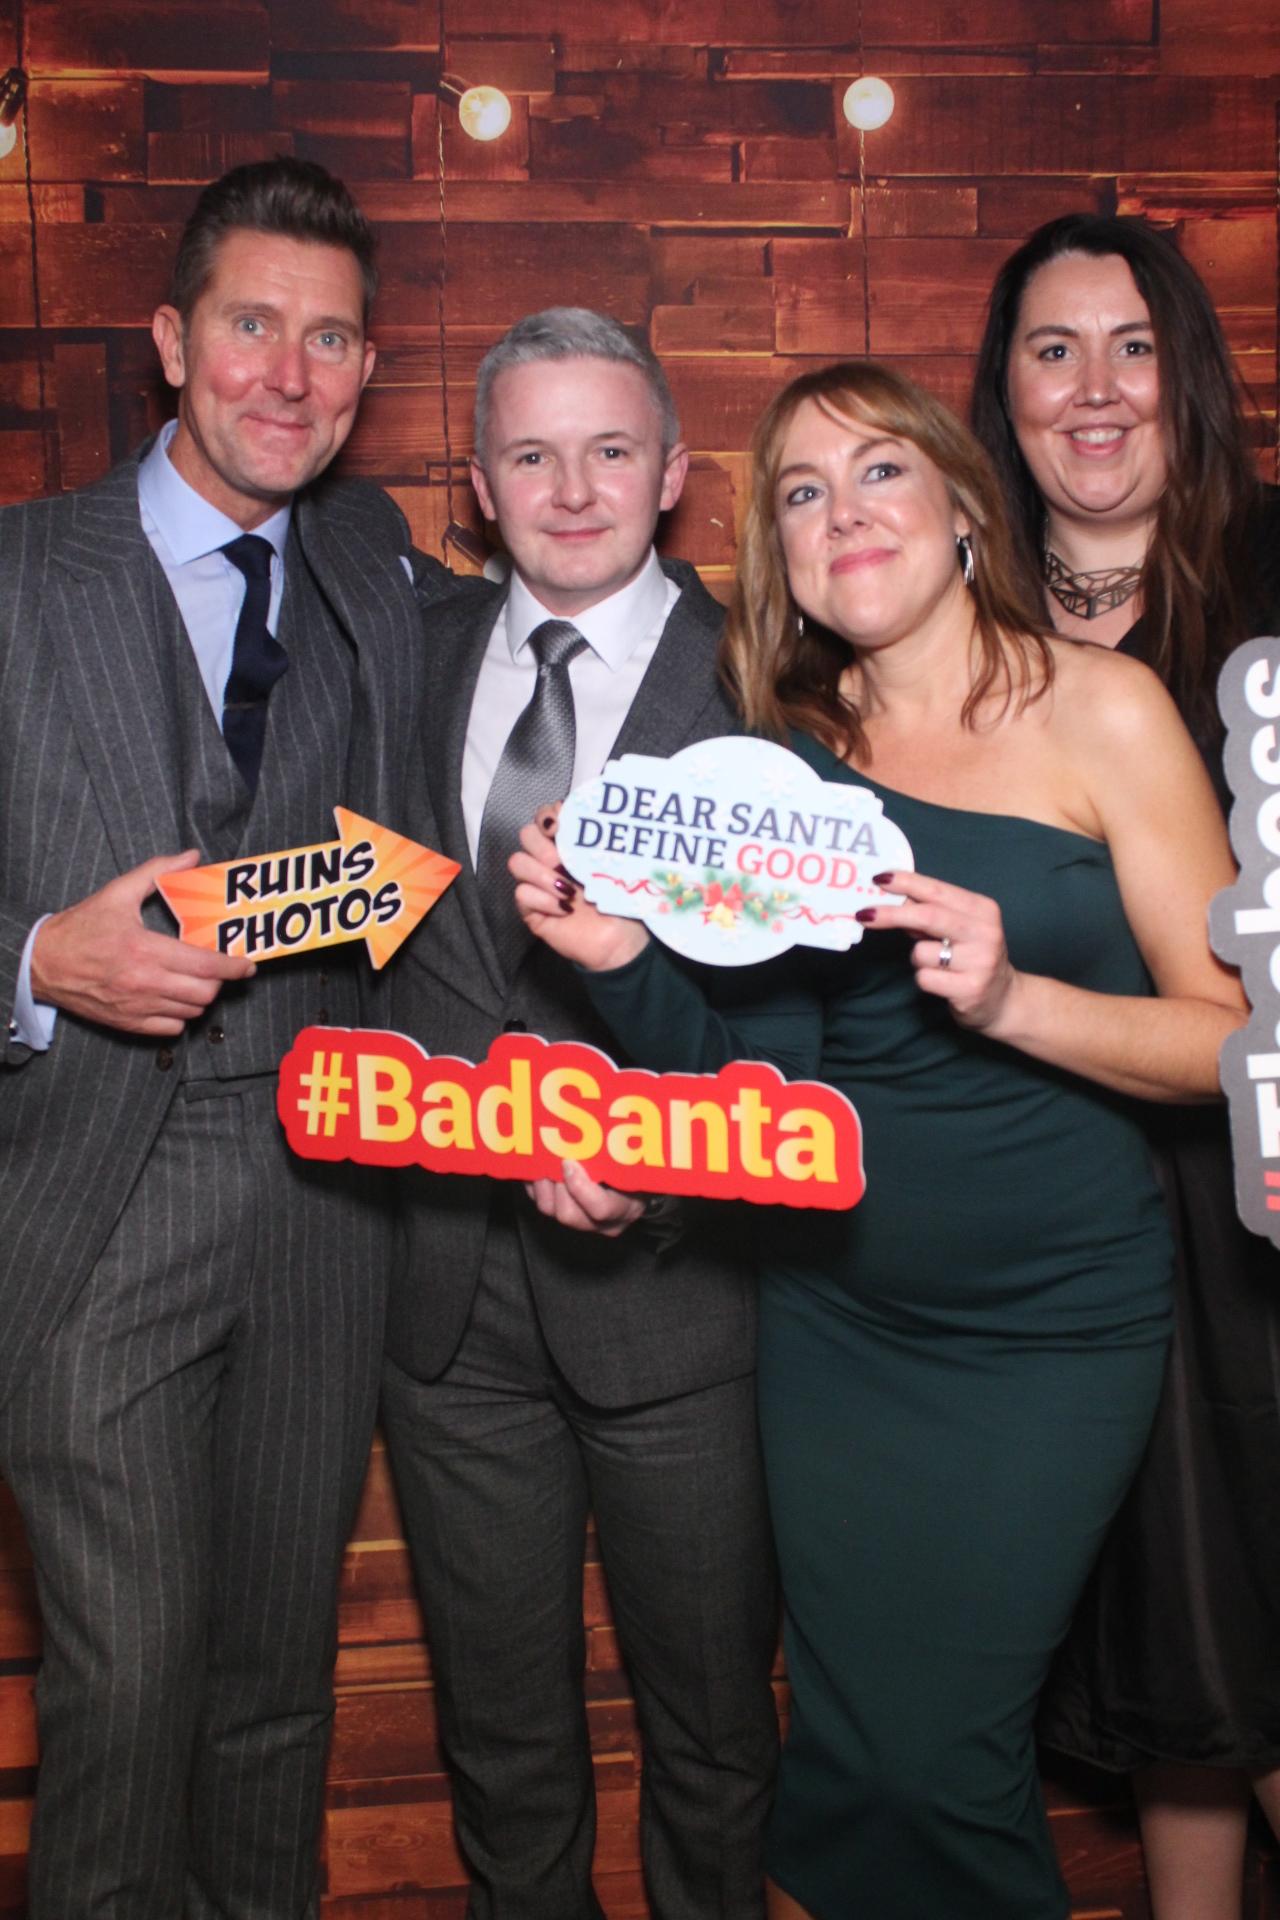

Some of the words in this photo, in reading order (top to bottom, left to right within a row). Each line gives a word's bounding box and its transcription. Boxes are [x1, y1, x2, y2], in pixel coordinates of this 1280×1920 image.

[574, 817, 728, 870] DEFINE
[598, 782, 717, 831] DEAR
[727, 802, 880, 857] SANTA
[226, 841, 376, 905] RUINS
[217, 881, 402, 954] PHOTOS
[296, 1050, 840, 1184] #BadSanta
